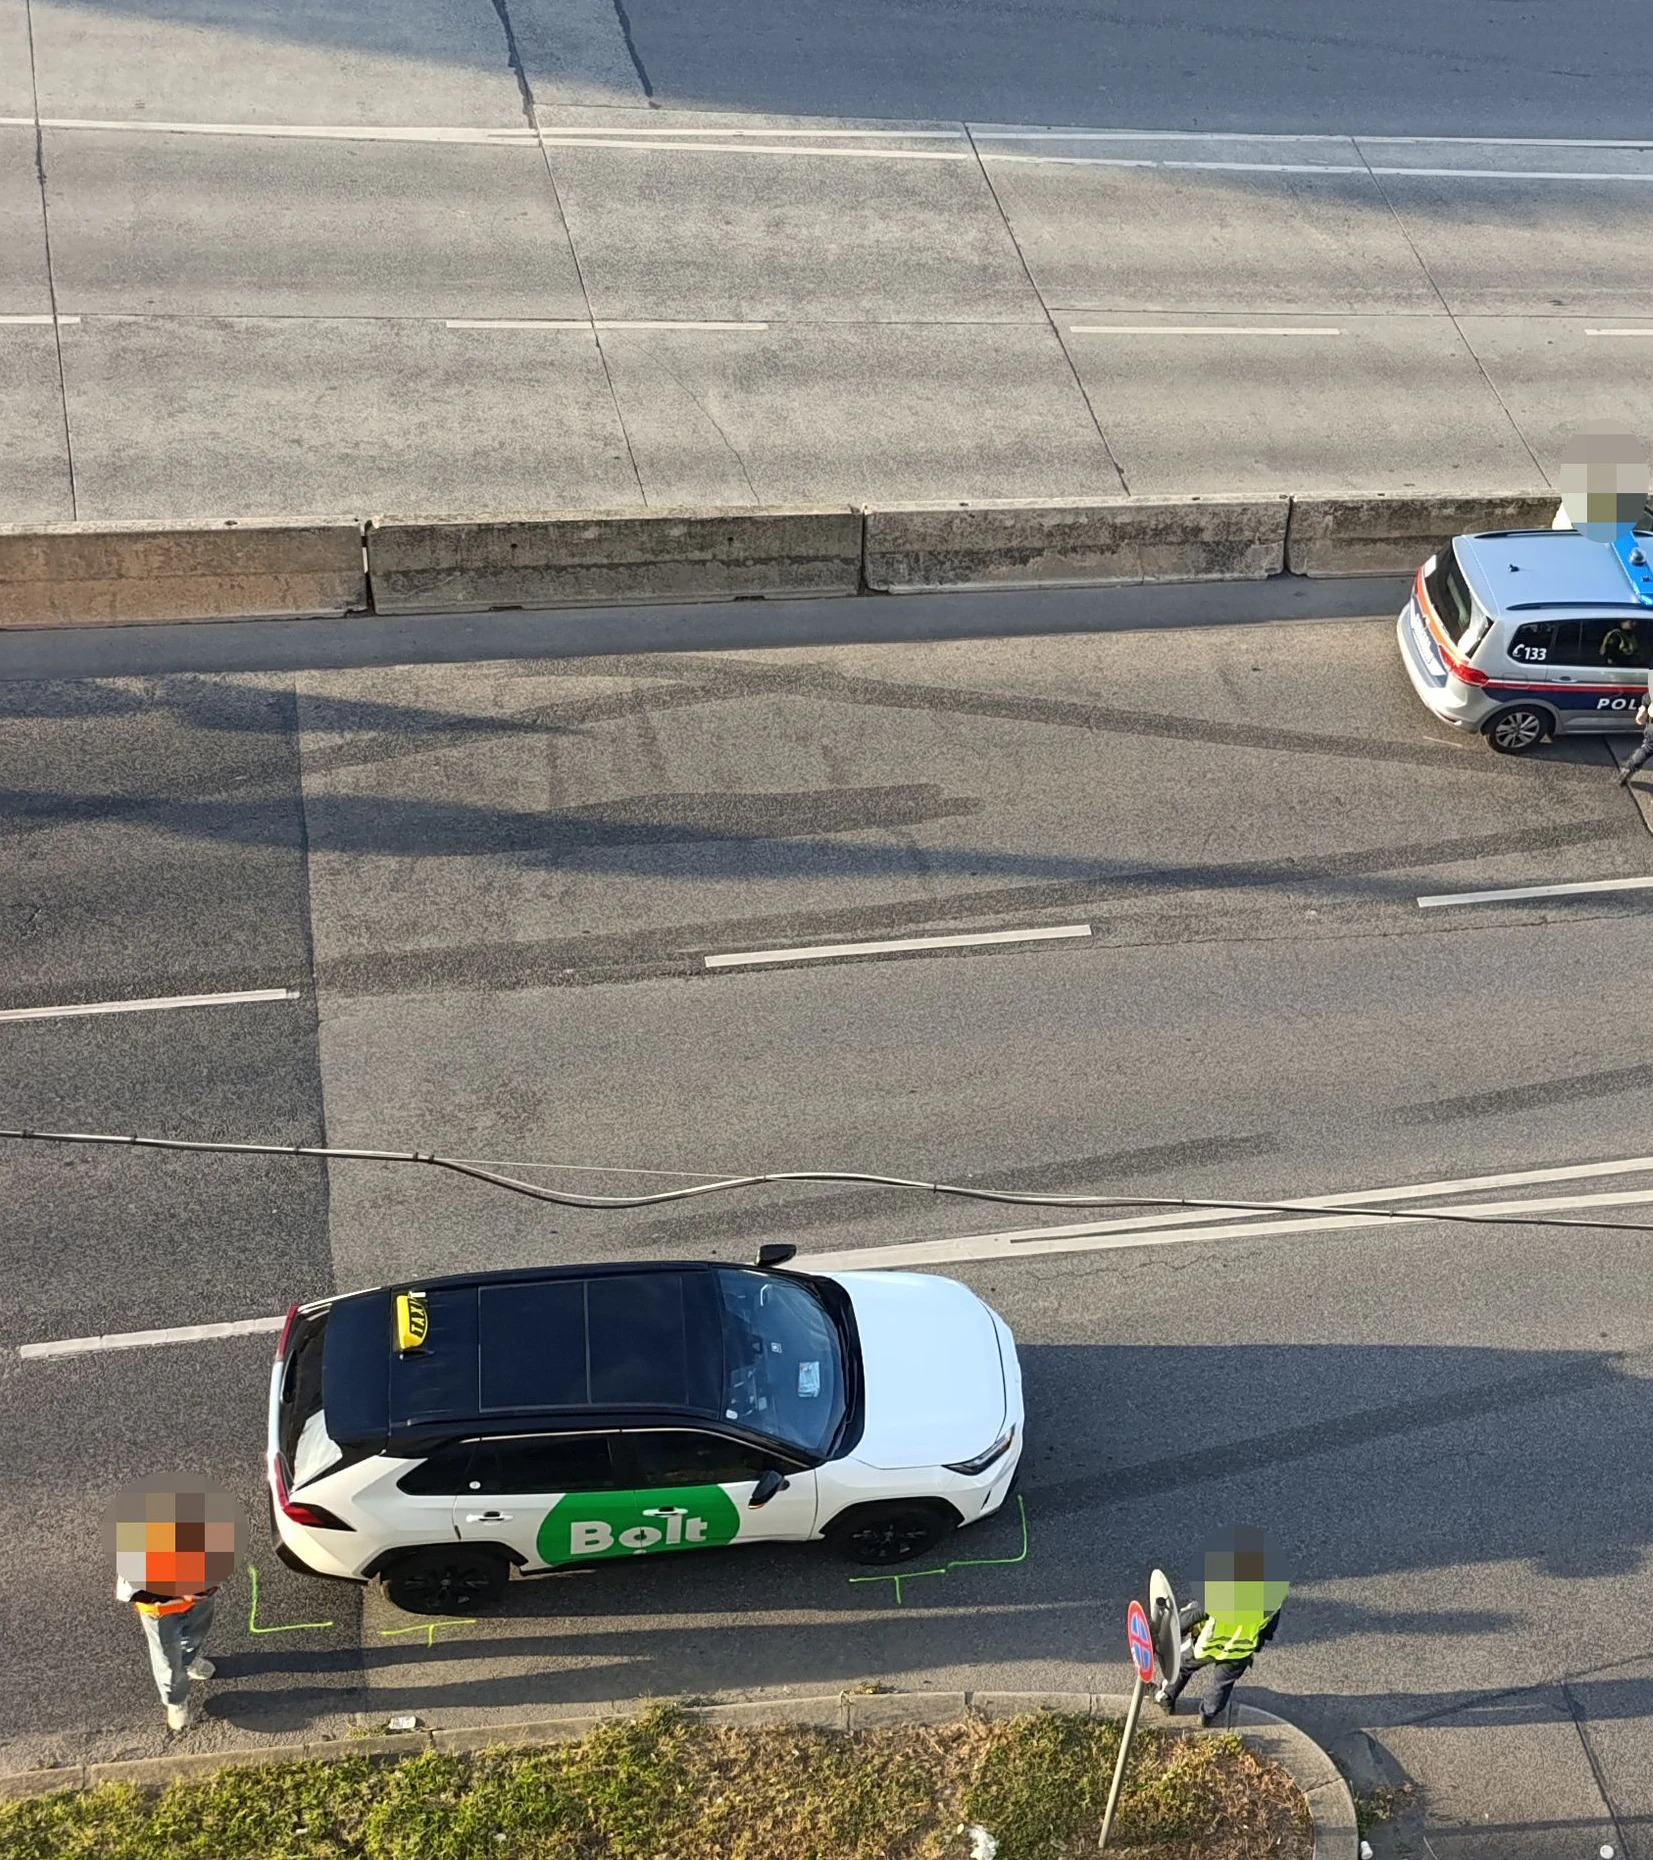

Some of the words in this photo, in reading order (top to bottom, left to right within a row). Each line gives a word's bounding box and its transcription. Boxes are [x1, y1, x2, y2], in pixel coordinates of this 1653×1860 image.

[1524, 647, 1547, 660] 133
[1596, 698, 1637, 710] POL
[570, 1511, 708, 1556] Bolt
